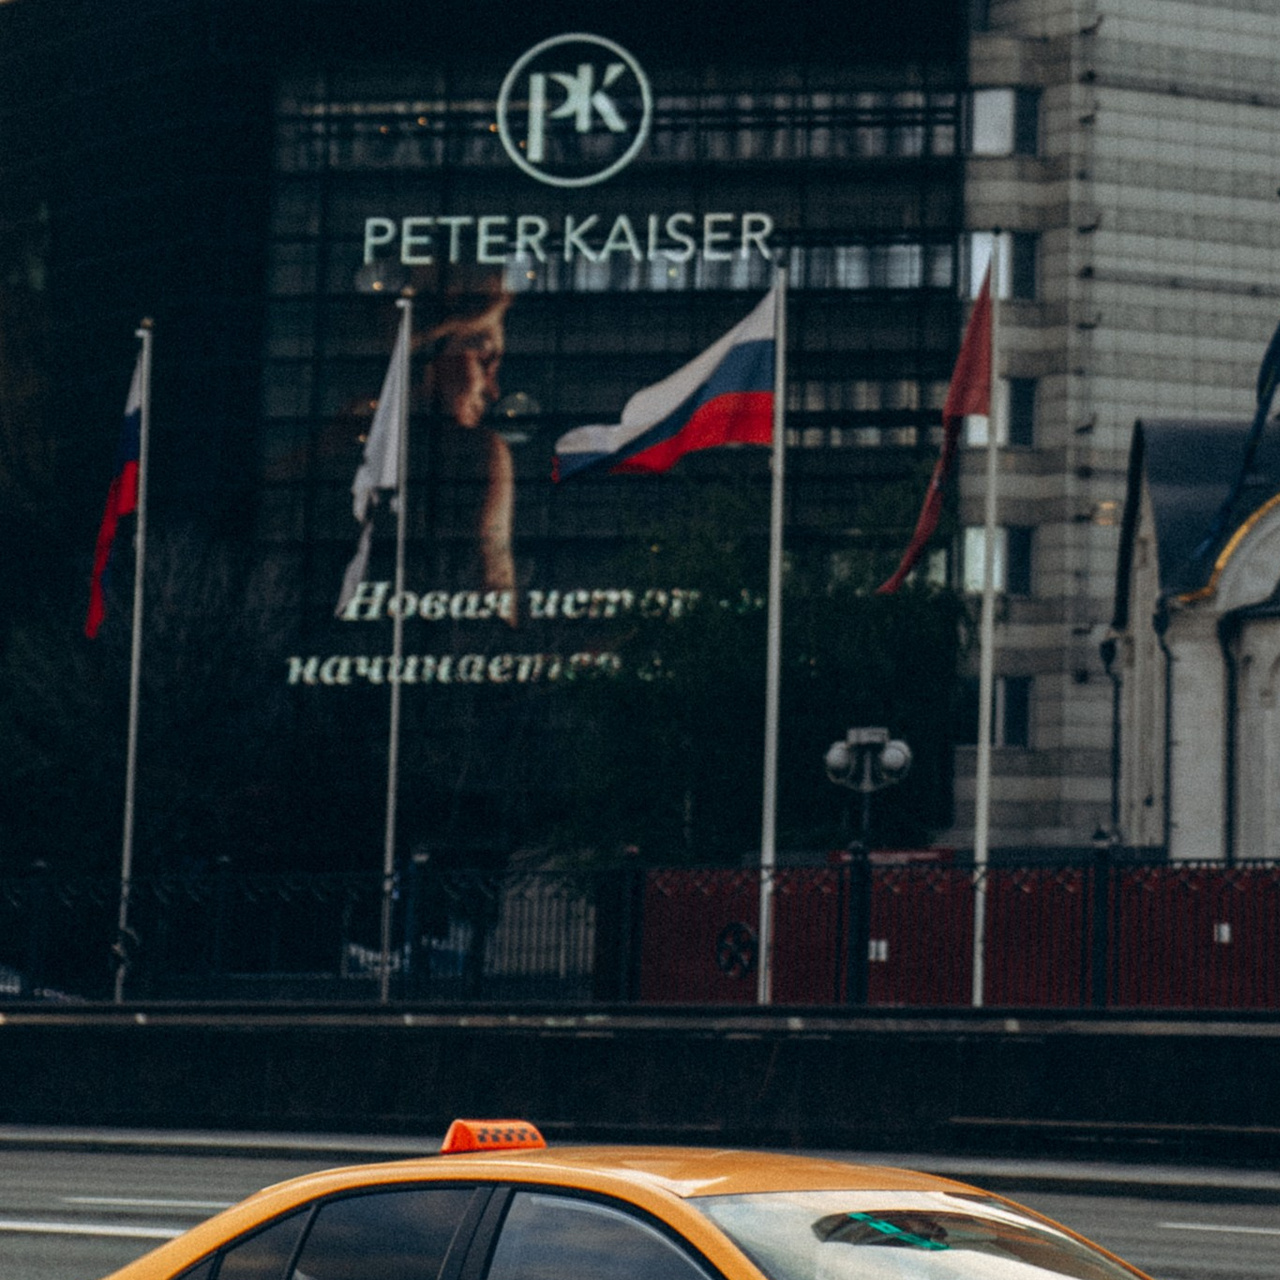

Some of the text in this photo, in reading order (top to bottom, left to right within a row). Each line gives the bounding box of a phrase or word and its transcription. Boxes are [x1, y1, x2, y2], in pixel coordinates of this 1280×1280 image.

[363, 212, 773, 265] PETER KAISER
[340, 580, 514, 621] Новая
